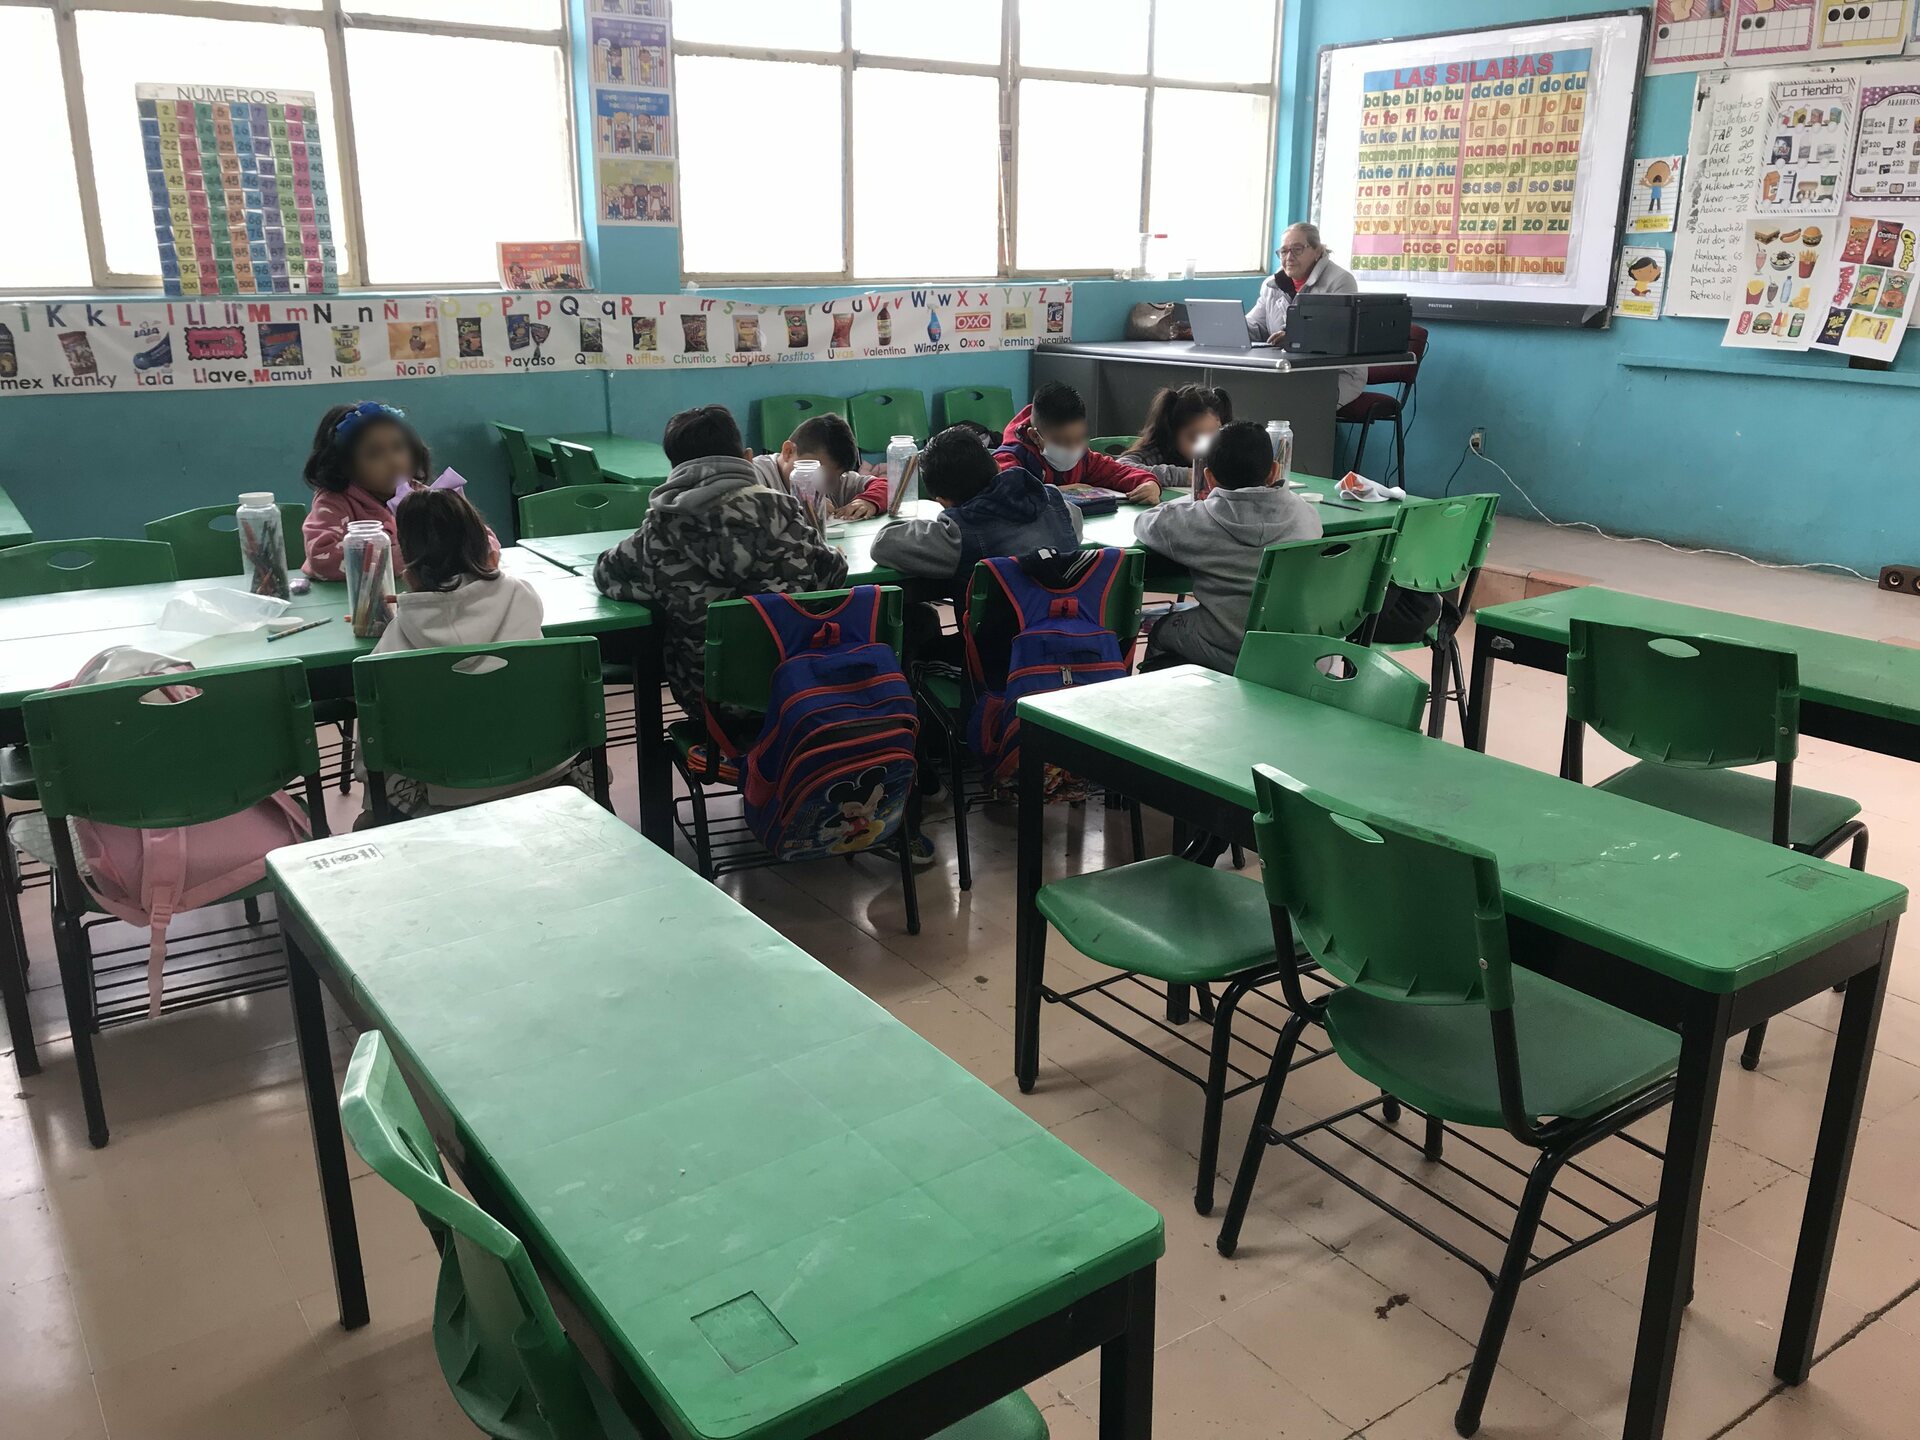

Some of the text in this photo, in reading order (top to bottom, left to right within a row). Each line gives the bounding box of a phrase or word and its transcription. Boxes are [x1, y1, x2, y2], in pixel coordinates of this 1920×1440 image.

[1394, 53, 1553, 89] LAS SILABAS
[1472, 74, 1586, 98] da de di do du
[1783, 84, 1842, 97] La tiendita
[1364, 86, 1464, 108] ba be bi bo bu
[1364, 105, 1460, 126] fa fe fi fo fu
[1361, 125, 1459, 144] ka ke ki ko ku
[1466, 139, 1579, 157] na ne ni no nu
[1710, 143, 1732, 155] ACE
[1358, 182, 1453, 196] ra re ri ro ru
[1462, 178, 1574, 194] sa se si so su
[1459, 217, 1569, 231] za ze zi zo zu
[1899, 229, 1916, 271] Cheetos
[182, 264, 196, 273] 92
[236, 264, 250, 272] 95
[46, 305, 67, 327] K
[86, 304, 106, 326] k
[117, 305, 131, 326] L
[248, 304, 271, 322] M
[287, 308, 308, 320] m
[314, 303, 332, 323] N
[358, 306, 373, 322] n
[384, 300, 398, 320] Ñ
[501, 297, 513, 316] P
[537, 300, 551, 320] p
[560, 296, 579, 316] Q
[602, 301, 616, 320] q
[621, 297, 633, 315] R
[659, 301, 666, 315] r
[701, 299, 716, 311] rr
[723, 301, 736, 314] S
[868, 296, 881, 312] V
[911, 291, 927, 308] W
[938, 293, 951, 306] w
[957, 290, 968, 307] X
[1004, 288, 1012, 304] Y
[1023, 292, 1031, 307] y
[1039, 288, 1047, 303] Z
[957, 316, 990, 328] OXXO
[52, 374, 117, 388] Kranky
[137, 372, 173, 385] Lala
[193, 368, 247, 383] Llave
[254, 368, 312, 382] Mamut
[331, 365, 367, 378] Nido
[396, 362, 436, 376] Ñoño
[447, 358, 495, 369] Ondas
[505, 356, 555, 367] Payaso
[626, 353, 665, 364] Ruffles
[674, 354, 716, 363] Churritos
[777, 351, 814, 362] Tostitos
[864, 346, 906, 356] Valentina
[914, 343, 950, 353] Windex
[960, 338, 985, 347] Oxxo
